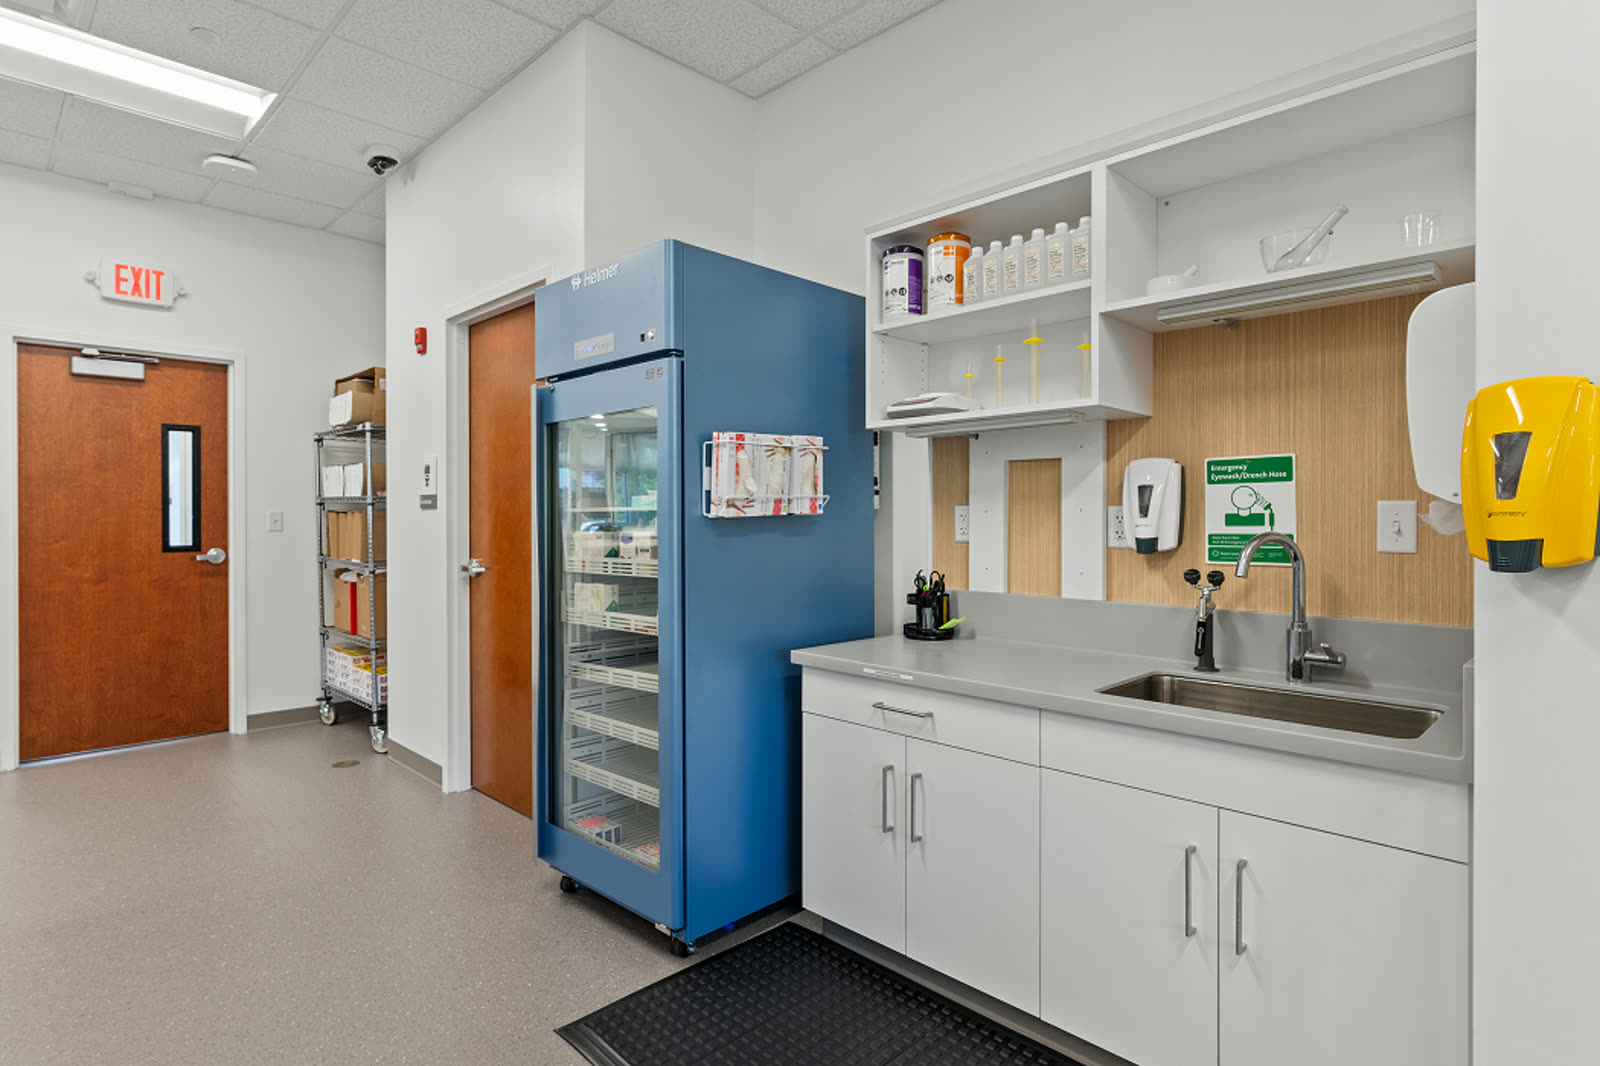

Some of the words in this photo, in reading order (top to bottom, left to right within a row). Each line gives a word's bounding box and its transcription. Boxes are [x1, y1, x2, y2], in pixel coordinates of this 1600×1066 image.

[115, 264, 165, 300] EXIT
[583, 264, 620, 288] Helmer
[1210, 464, 1247, 472] Emergency
[1210, 472, 1268, 481] Eyewash/Drench
